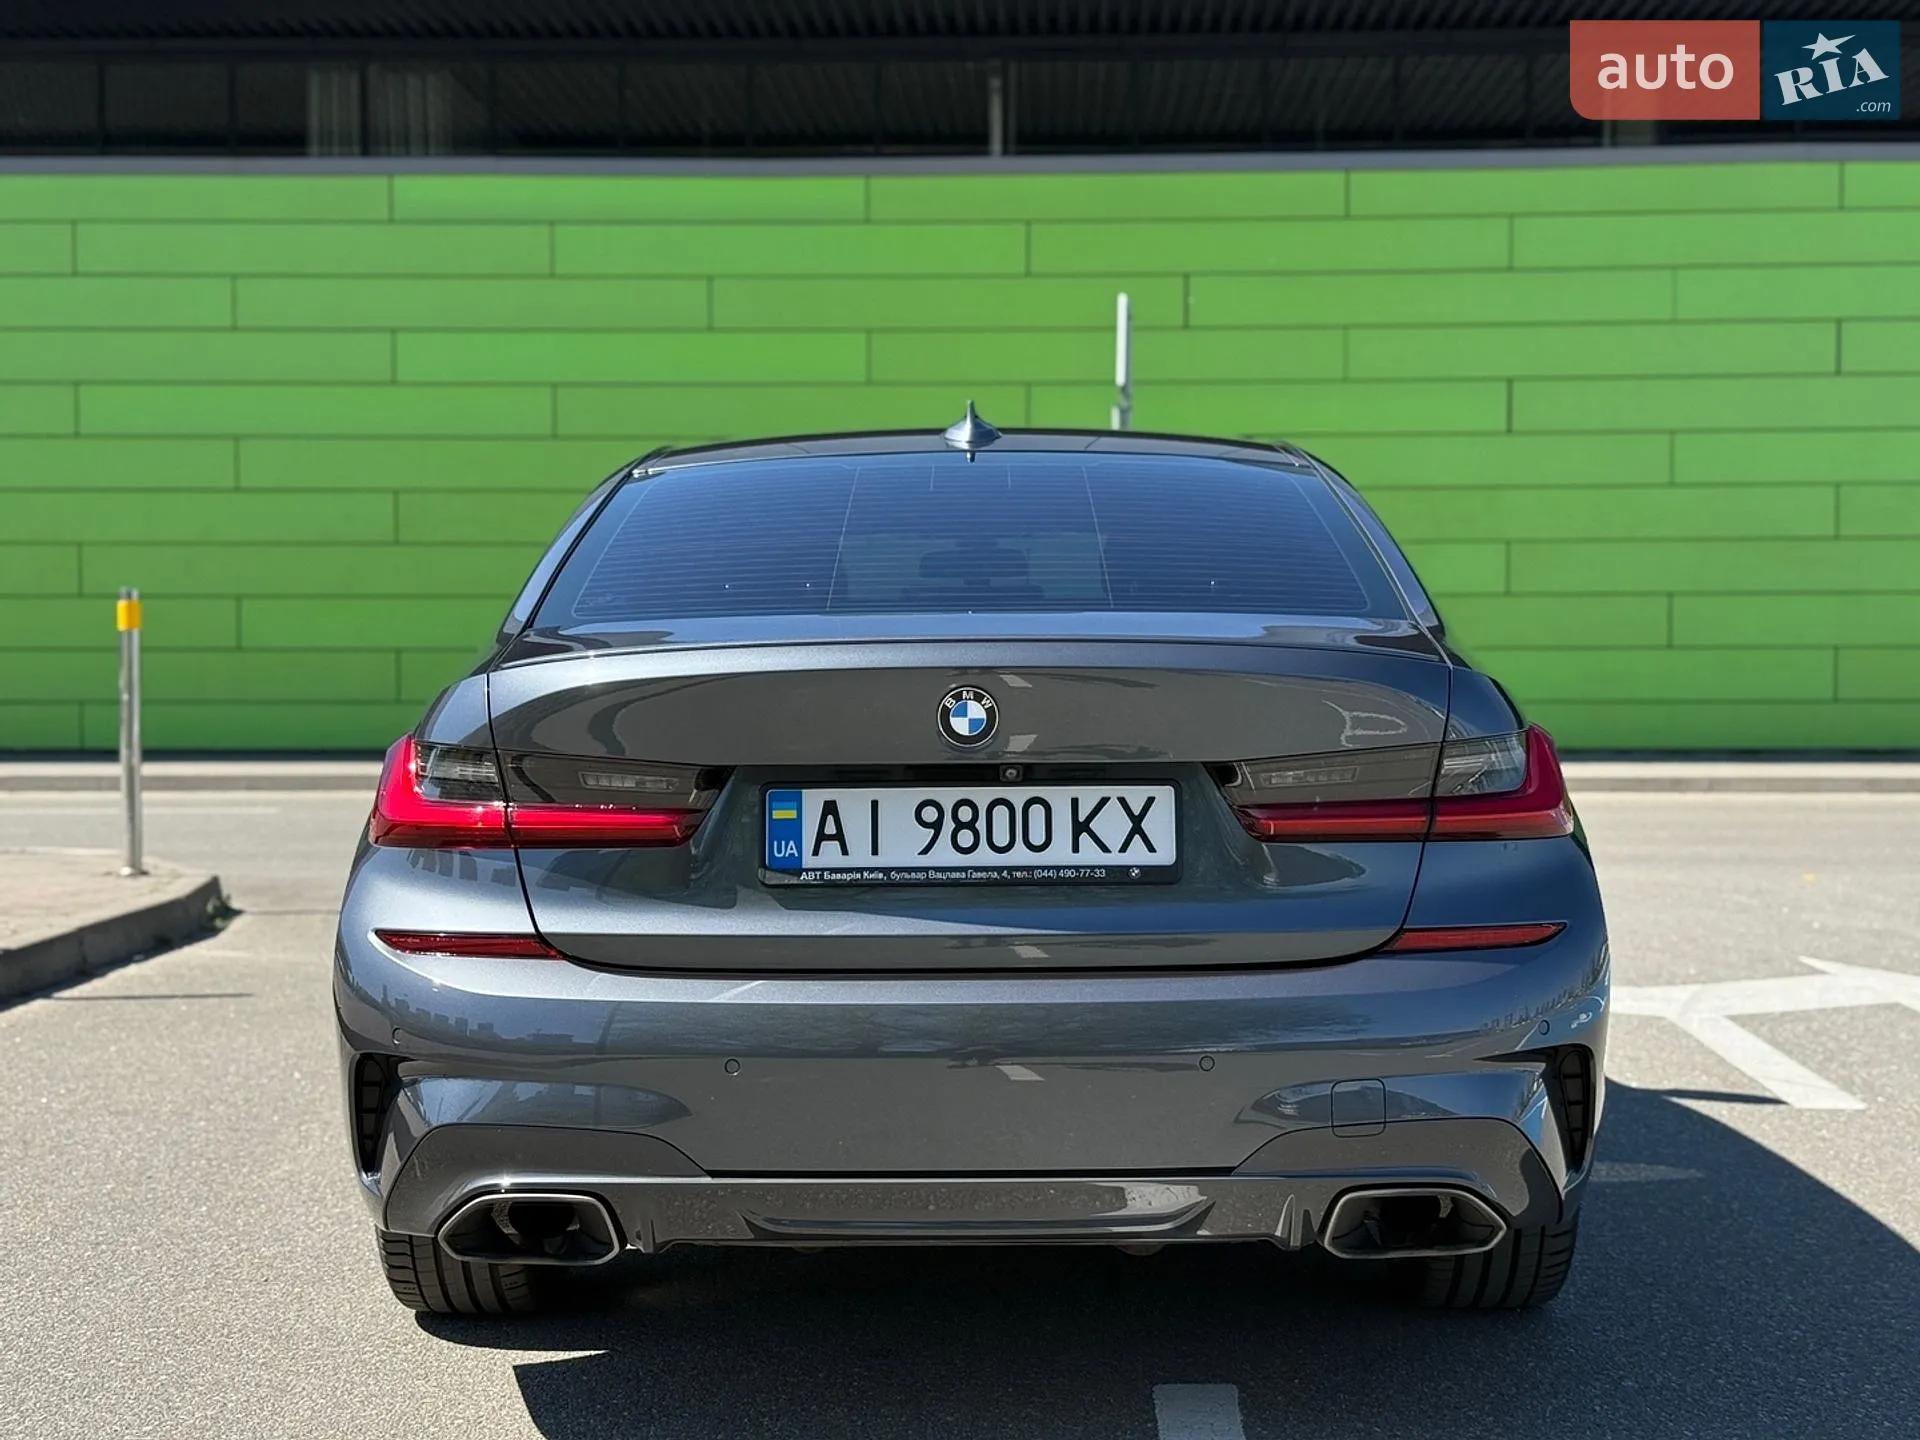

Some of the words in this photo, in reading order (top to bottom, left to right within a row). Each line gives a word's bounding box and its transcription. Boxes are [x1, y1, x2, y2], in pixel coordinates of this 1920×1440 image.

[811, 799, 879, 856] AI
[914, 796, 1053, 856] 9800
[1070, 796, 1157, 854] KX
[774, 840, 798, 857] UA
[824, 871, 861, 881] Баварія
[890, 870, 927, 881] бульвар
[1034, 869, 1057, 879] (044)
[1058, 869, 1106, 878] 490-77-33
